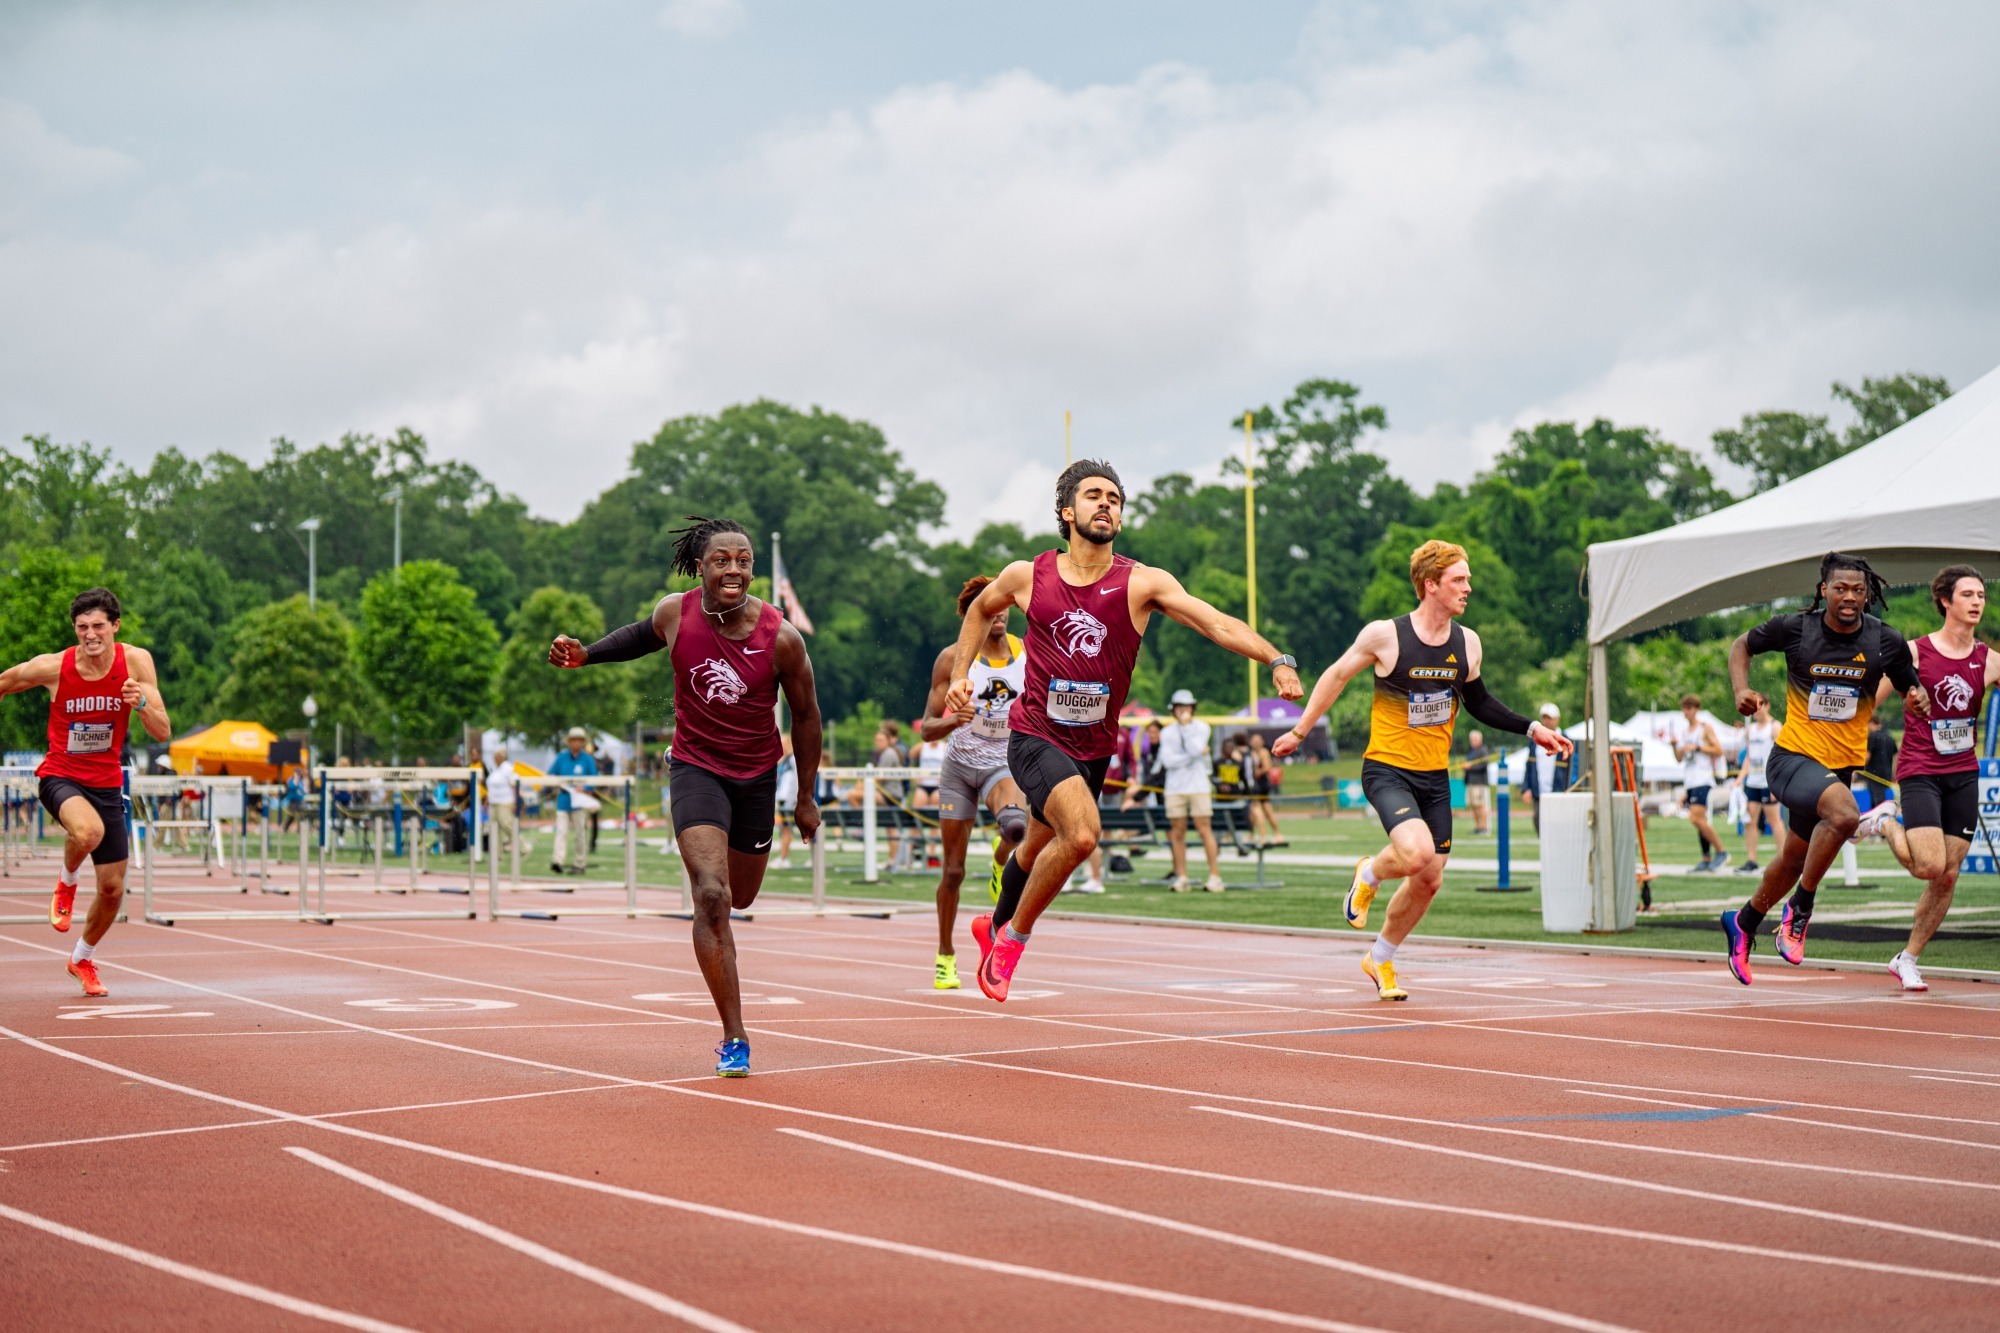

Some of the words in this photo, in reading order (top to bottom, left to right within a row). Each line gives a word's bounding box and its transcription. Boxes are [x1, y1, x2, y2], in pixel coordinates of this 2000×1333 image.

[1411, 669, 1455, 678] CENTRE
[1812, 666, 1863, 677] CENTRE
[65, 695, 122, 713] RHODES
[1056, 693, 1102, 708] DUGGAN
[1818, 696, 1847, 708] LEWIS
[1068, 707, 1089, 715] TRINITY
[1409, 699, 1451, 714] VELIQUETTE
[982, 718, 1006, 729] WHITE
[72, 732, 111, 742] TUCHNER
[1938, 728, 1968, 740] SELMAN
